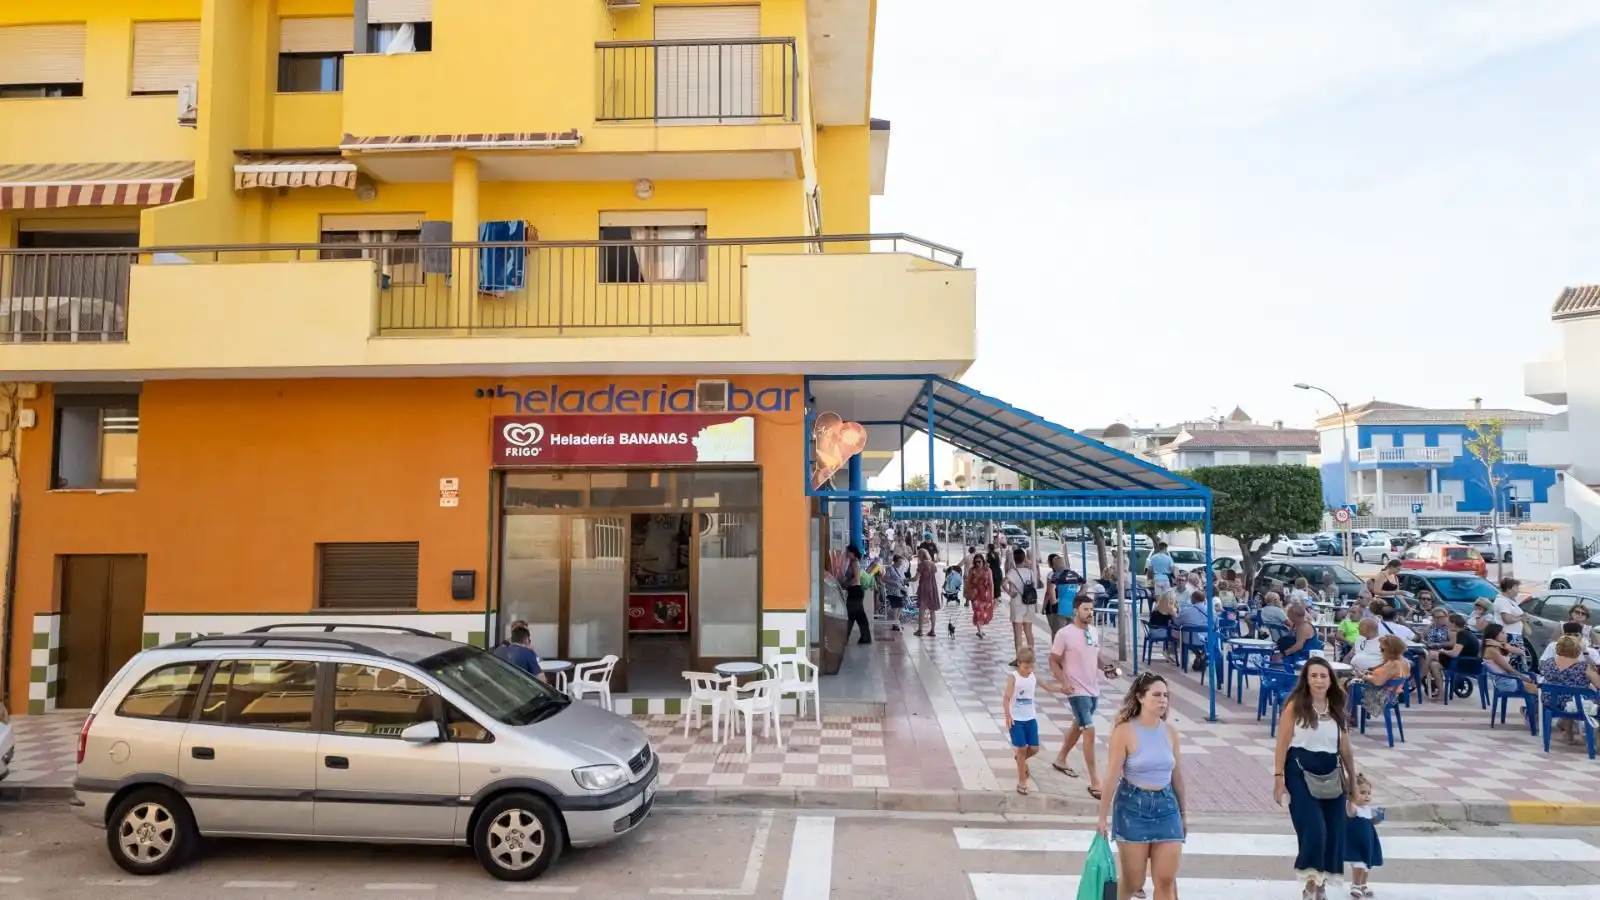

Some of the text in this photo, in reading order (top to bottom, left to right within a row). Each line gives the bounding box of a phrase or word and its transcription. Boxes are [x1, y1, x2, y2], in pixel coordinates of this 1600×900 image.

[496, 383, 800, 413] heladeria bar
[550, 433, 688, 445] Heladería BANANAS
[505, 447, 539, 457] FRIGO
